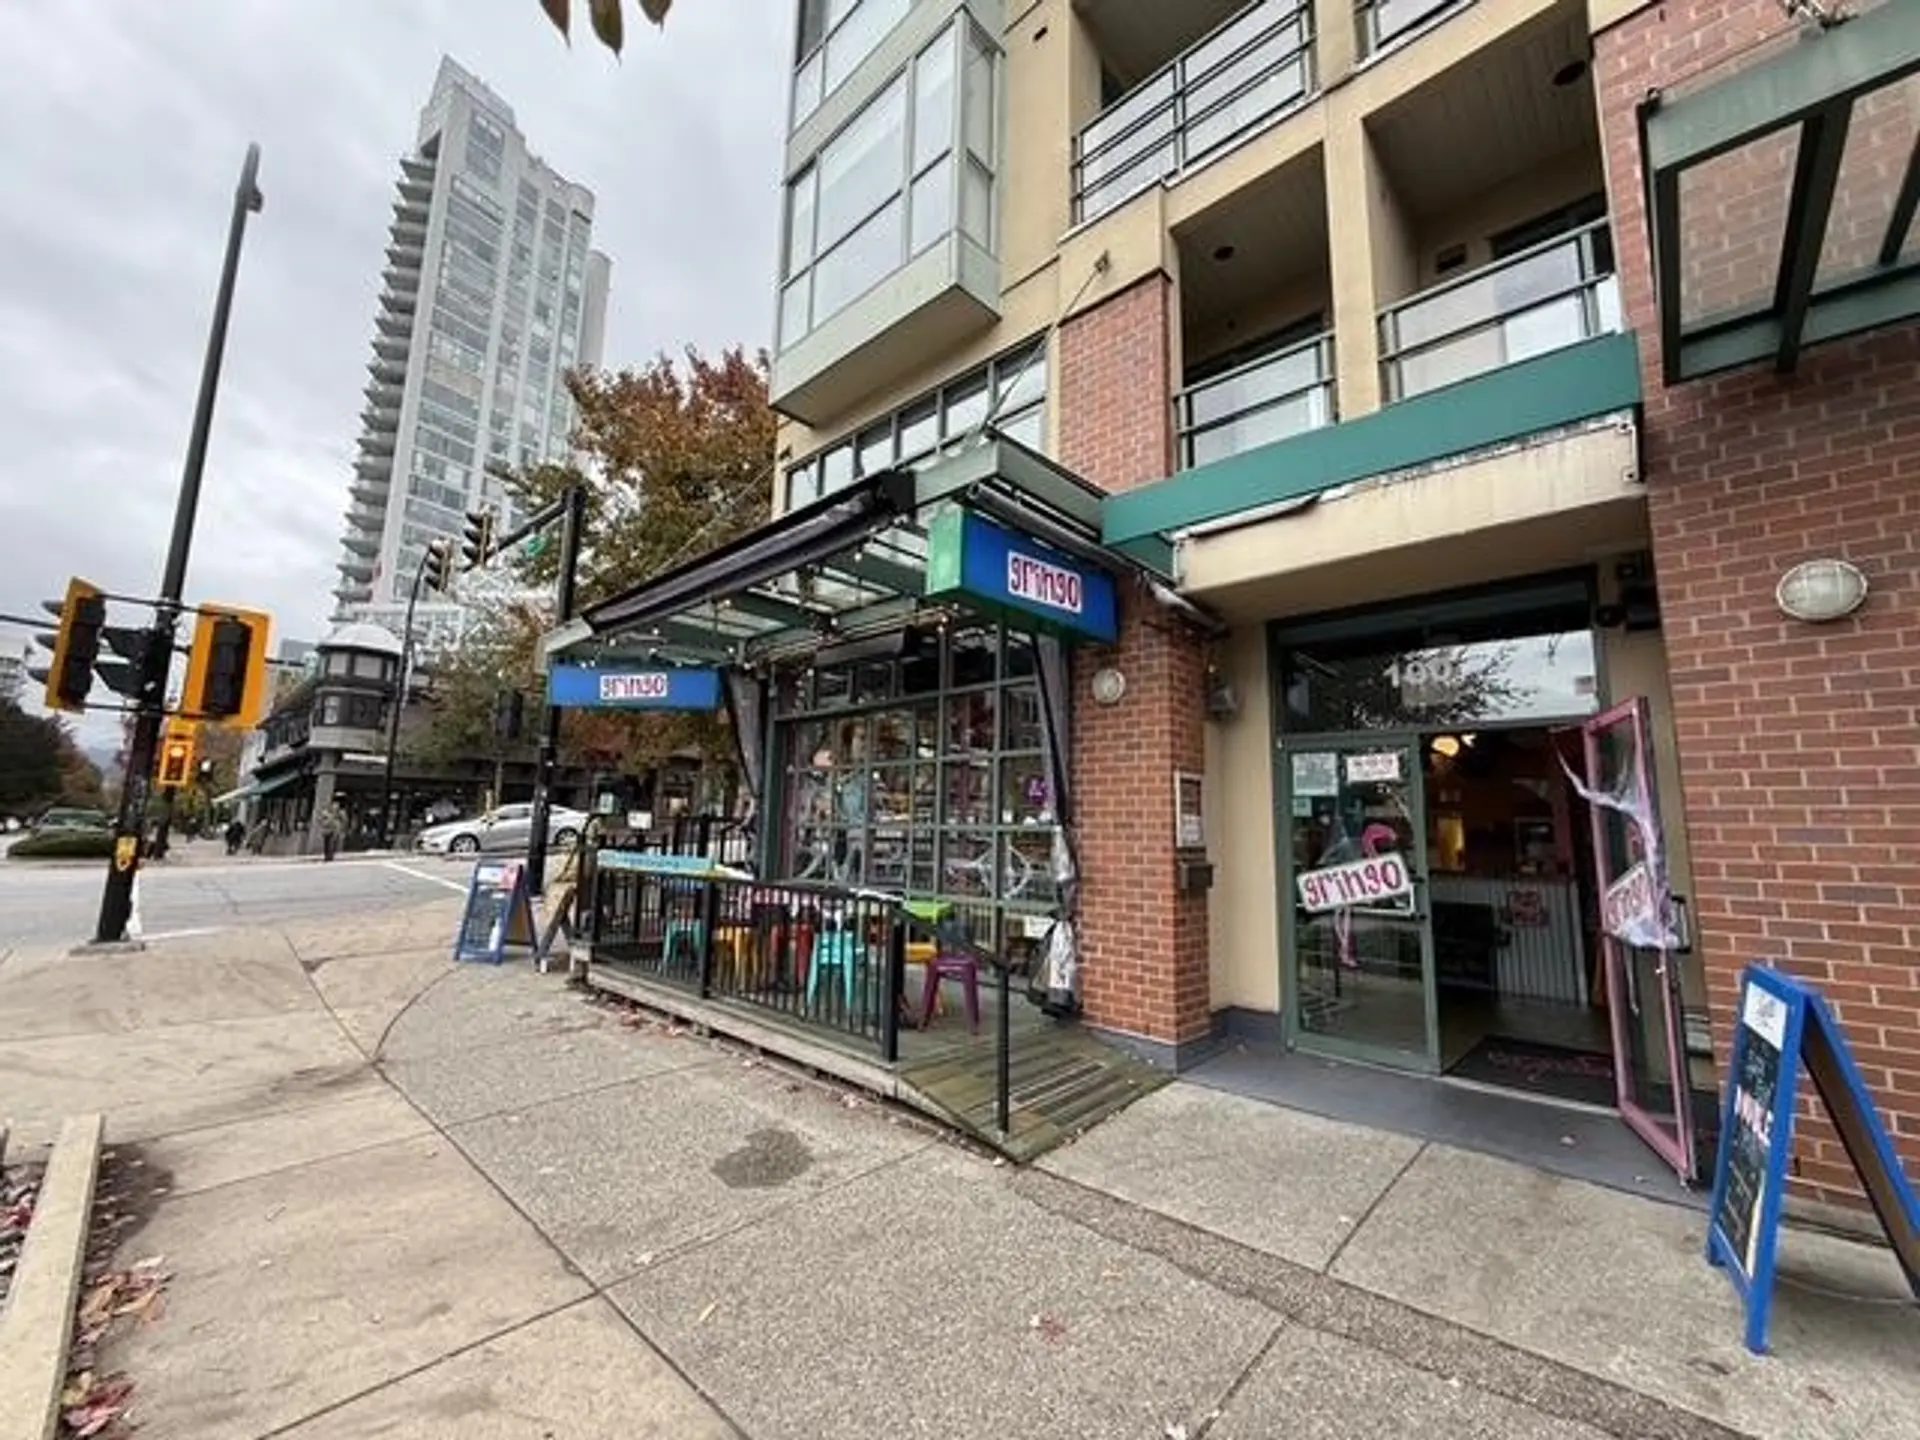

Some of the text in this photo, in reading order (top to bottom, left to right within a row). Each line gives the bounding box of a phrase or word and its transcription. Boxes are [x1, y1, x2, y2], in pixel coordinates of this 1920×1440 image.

[1011, 556, 1079, 608] gringo
[602, 674, 664, 697] gringo
[1305, 860, 1402, 907] gringo
